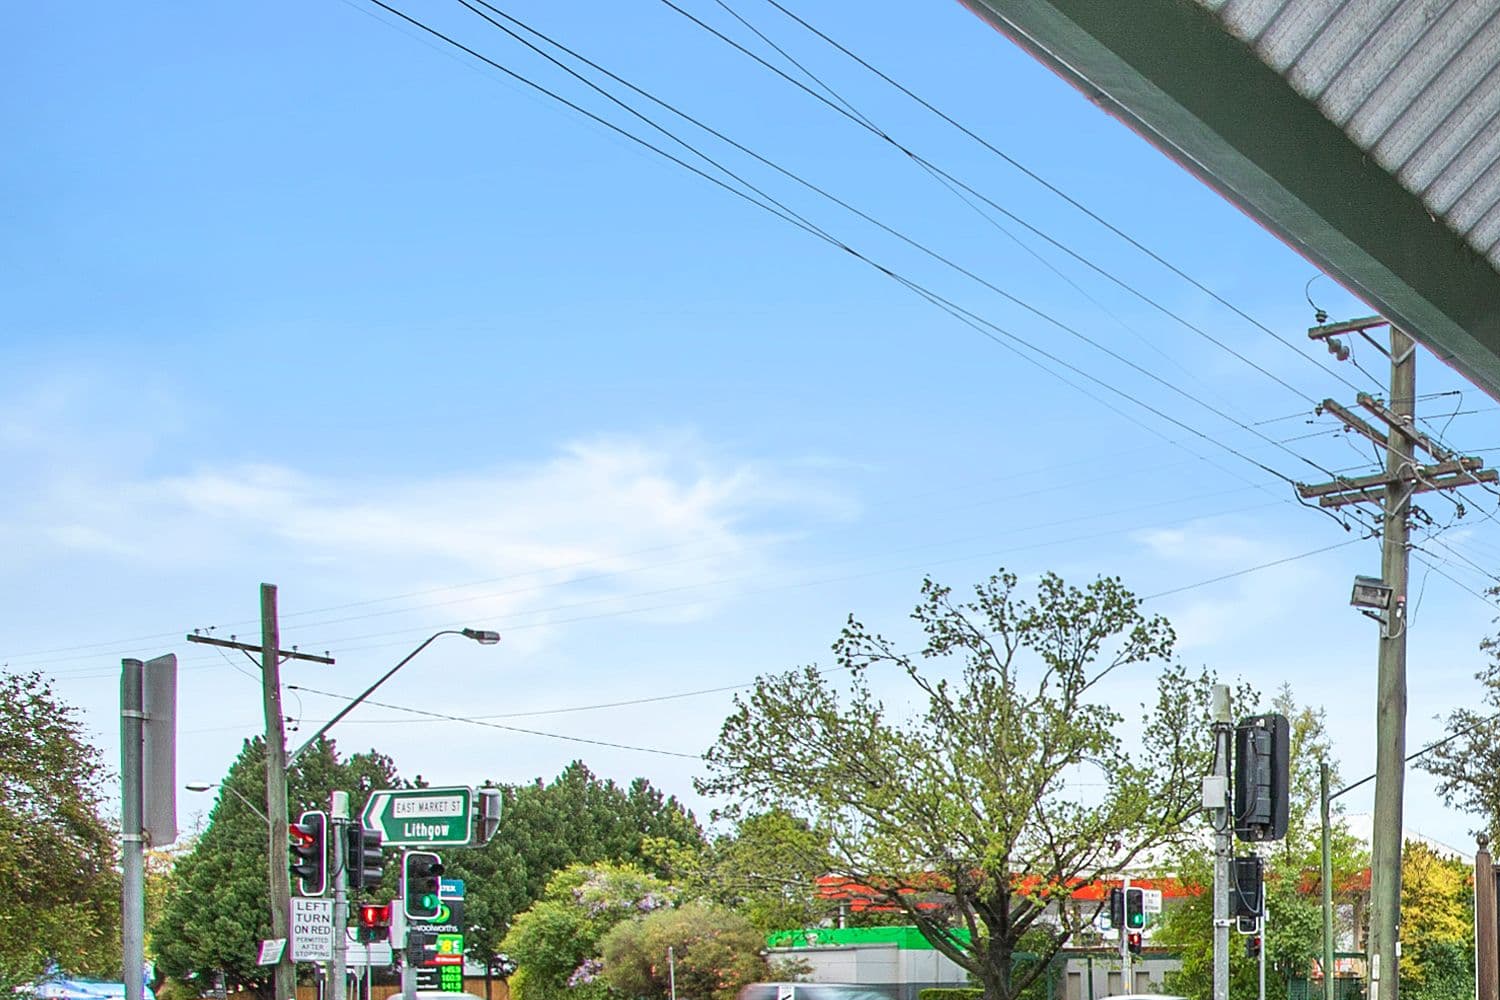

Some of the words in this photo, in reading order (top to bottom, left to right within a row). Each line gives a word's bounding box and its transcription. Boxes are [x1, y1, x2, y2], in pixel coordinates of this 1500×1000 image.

[396, 802, 415, 813] EAST
[419, 801, 448, 812] MARKET
[451, 801, 460, 811] ST
[404, 823, 449, 840] Lithgow
[297, 902, 328, 911] LEFT
[295, 913, 330, 923] TURN
[294, 925, 309, 934] ON
[311, 926, 331, 935] RED
